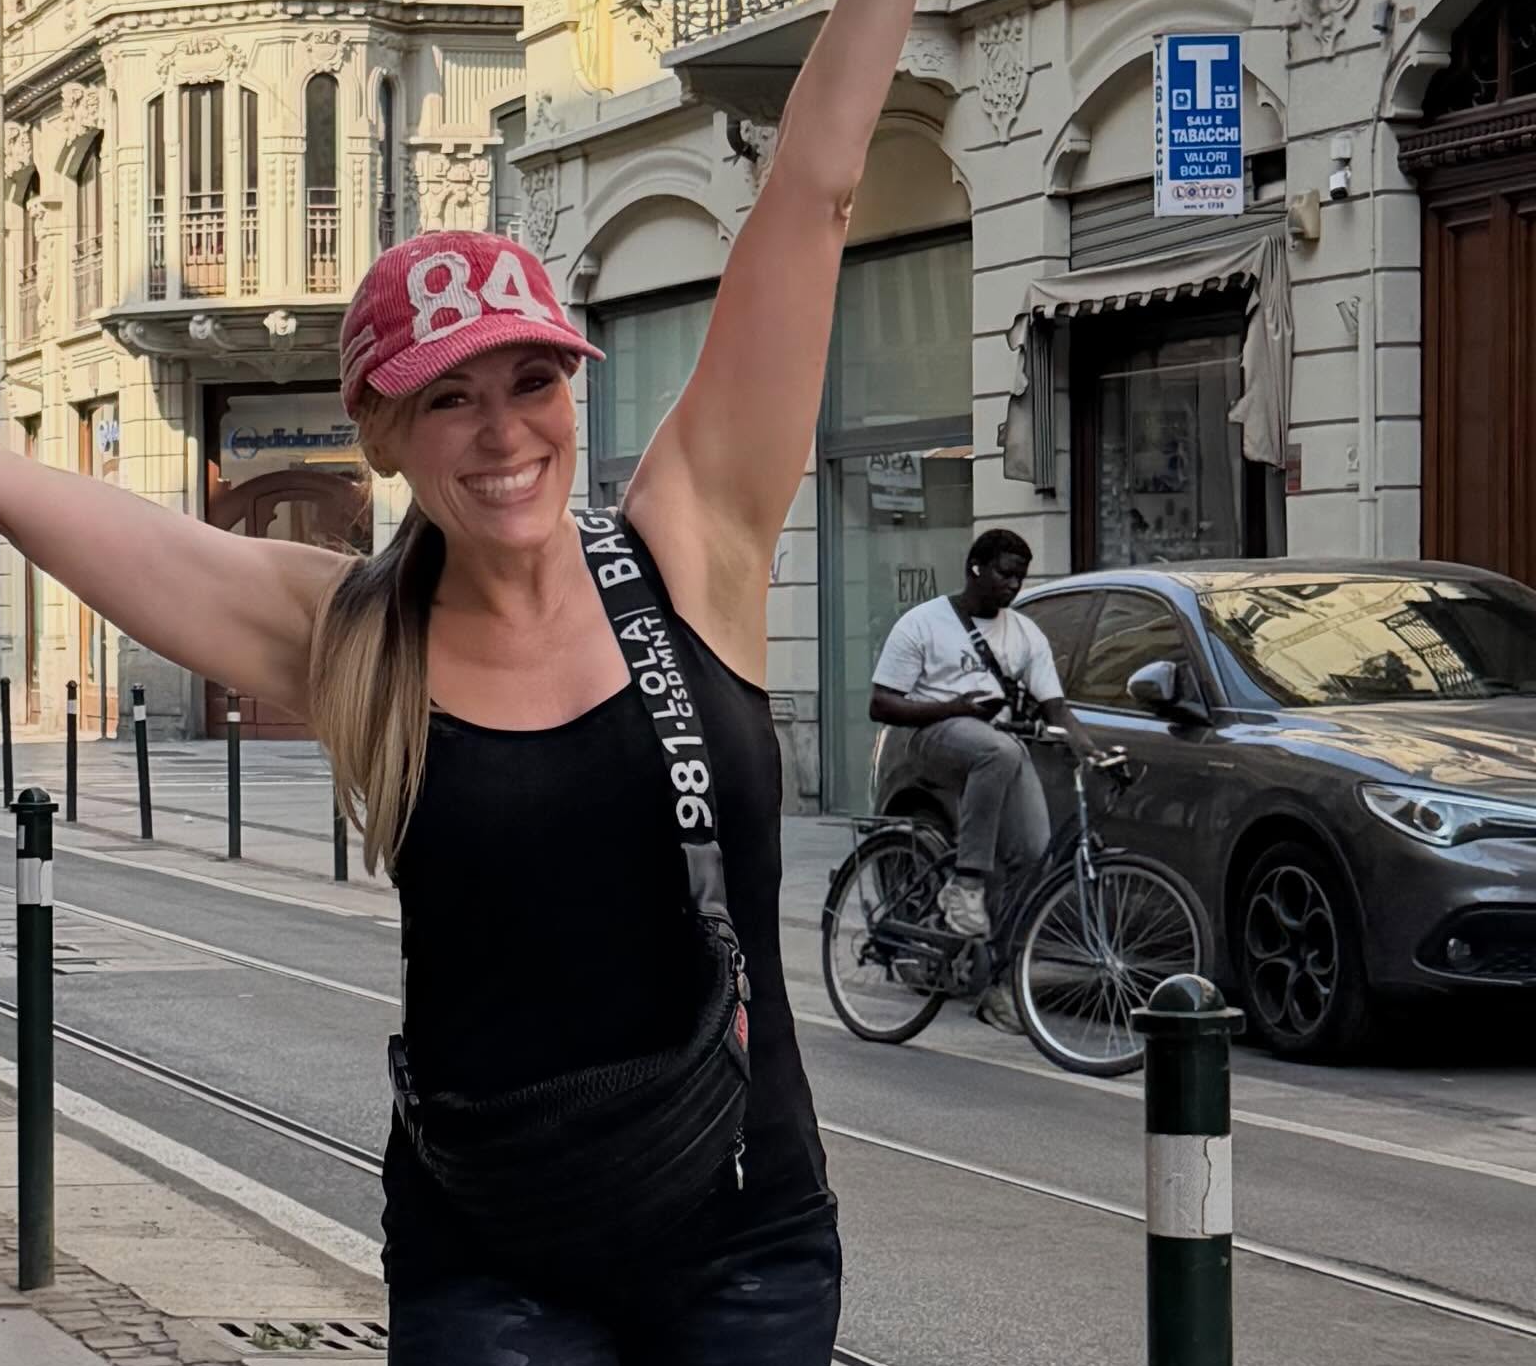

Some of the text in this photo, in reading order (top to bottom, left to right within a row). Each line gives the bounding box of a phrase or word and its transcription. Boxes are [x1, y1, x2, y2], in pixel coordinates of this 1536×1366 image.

[1178, 44, 1229, 110] T
[1155, 43, 1163, 208] TABACCHI
[1186, 116, 1212, 126] SALI
[1172, 127, 1239, 144] TABACCHI
[1184, 151, 1228, 163] VALORI
[1180, 164, 1231, 177] BOLLATI
[1173, 185, 1236, 200] LOTTO
[407, 250, 556, 345] 84
